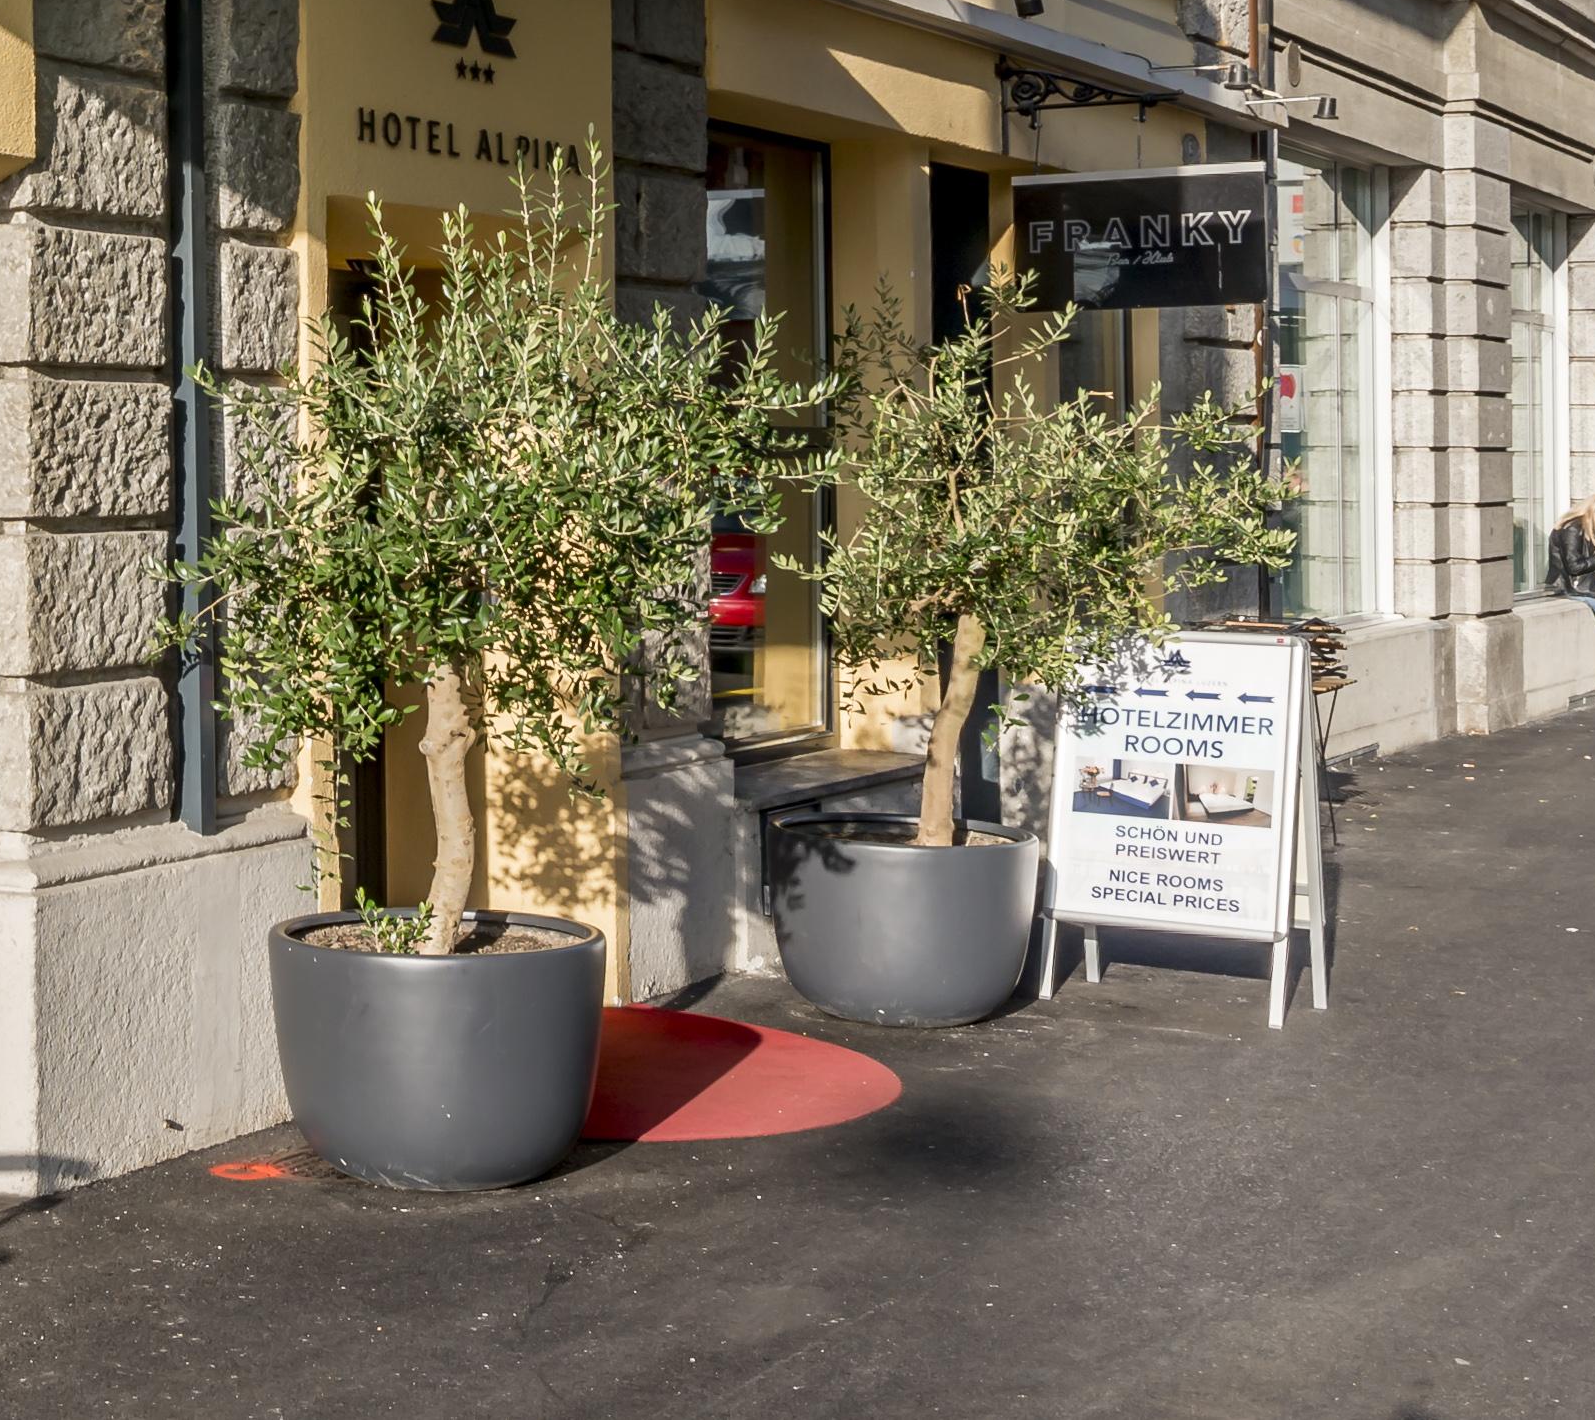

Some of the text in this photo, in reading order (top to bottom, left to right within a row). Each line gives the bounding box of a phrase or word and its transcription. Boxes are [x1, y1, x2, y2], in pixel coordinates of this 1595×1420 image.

[356, 106, 582, 177] HOTEL ALPINA
[1029, 209, 1252, 254] FRANKY
[1081, 706, 1274, 736] HOTELZIMMER
[1124, 735, 1224, 759] ROOMS
[1115, 824, 1223, 846] SCHÖN UND
[1115, 844, 1222, 865] PREISWERT
[1109, 869, 1224, 892] NICE ROOMS
[1091, 886, 1240, 913] SPECIAL PRICES
